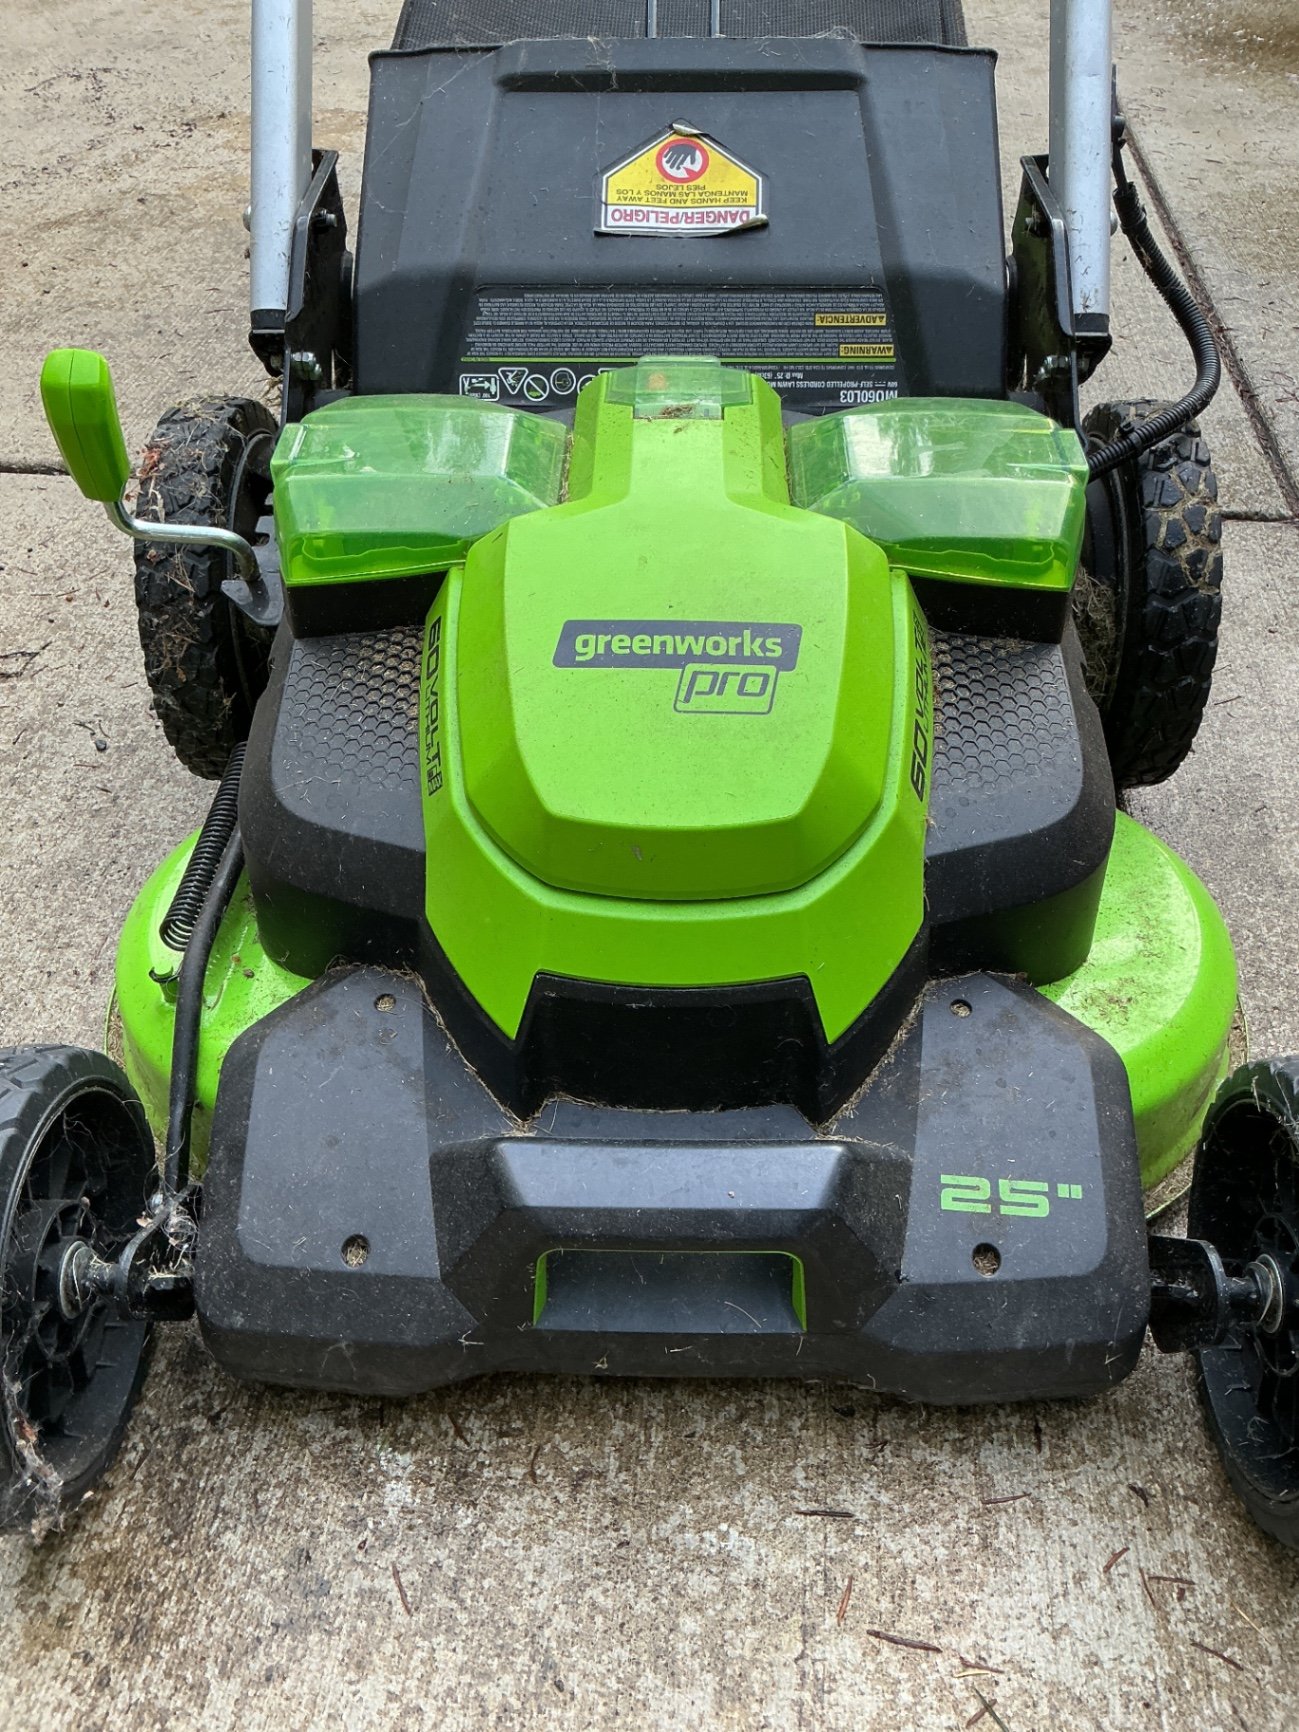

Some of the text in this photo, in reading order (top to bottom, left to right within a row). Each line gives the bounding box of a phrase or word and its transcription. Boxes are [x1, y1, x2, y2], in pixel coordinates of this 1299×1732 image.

[616, 188, 634, 196] LOS
[643, 189, 677, 197] MANOS
[698, 190, 749, 198] MANTENGA
[616, 195, 643, 203] AWAY
[690, 197, 721, 205] HANDS
[611, 208, 750, 224] DANGER/PELIGRO
[575, 630, 783, 661] greenworks
[683, 671, 770, 704] pro
[940, 1174, 1083, 1218] 25"
